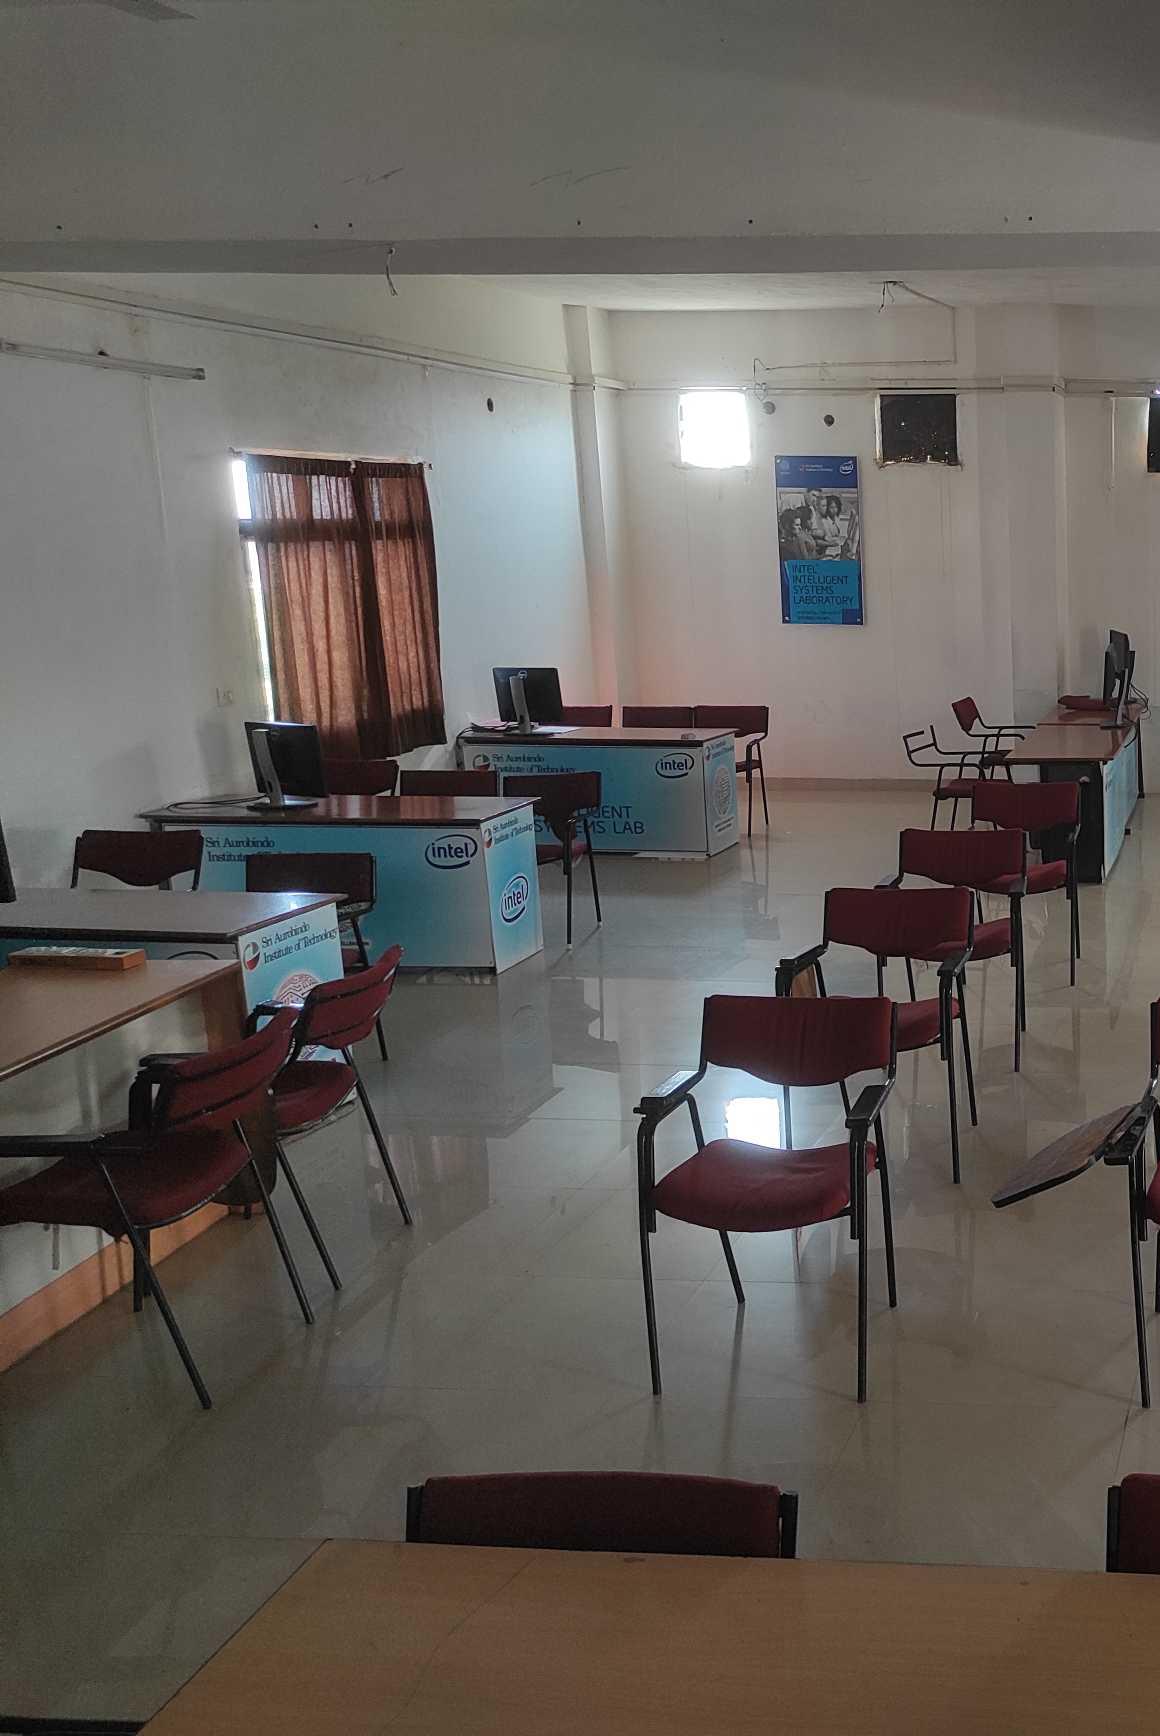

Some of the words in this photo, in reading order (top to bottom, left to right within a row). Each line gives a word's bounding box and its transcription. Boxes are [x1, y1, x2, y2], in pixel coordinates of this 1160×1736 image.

[793, 565, 816, 574] INTEL
[793, 575, 849, 585] INTELLIGENT
[793, 585, 834, 595] SYSTEMS
[794, 595, 855, 605] LABORATORY
[613, 821, 645, 835] LAB
[206, 836, 220, 848] Sri
[223, 836, 276, 848] Aurobindo
[261, 935, 273, 948] Sri
[274, 921, 311, 942] Aurobindo
[263, 943, 294, 964] Institute
[303, 927, 338, 949] Technology
